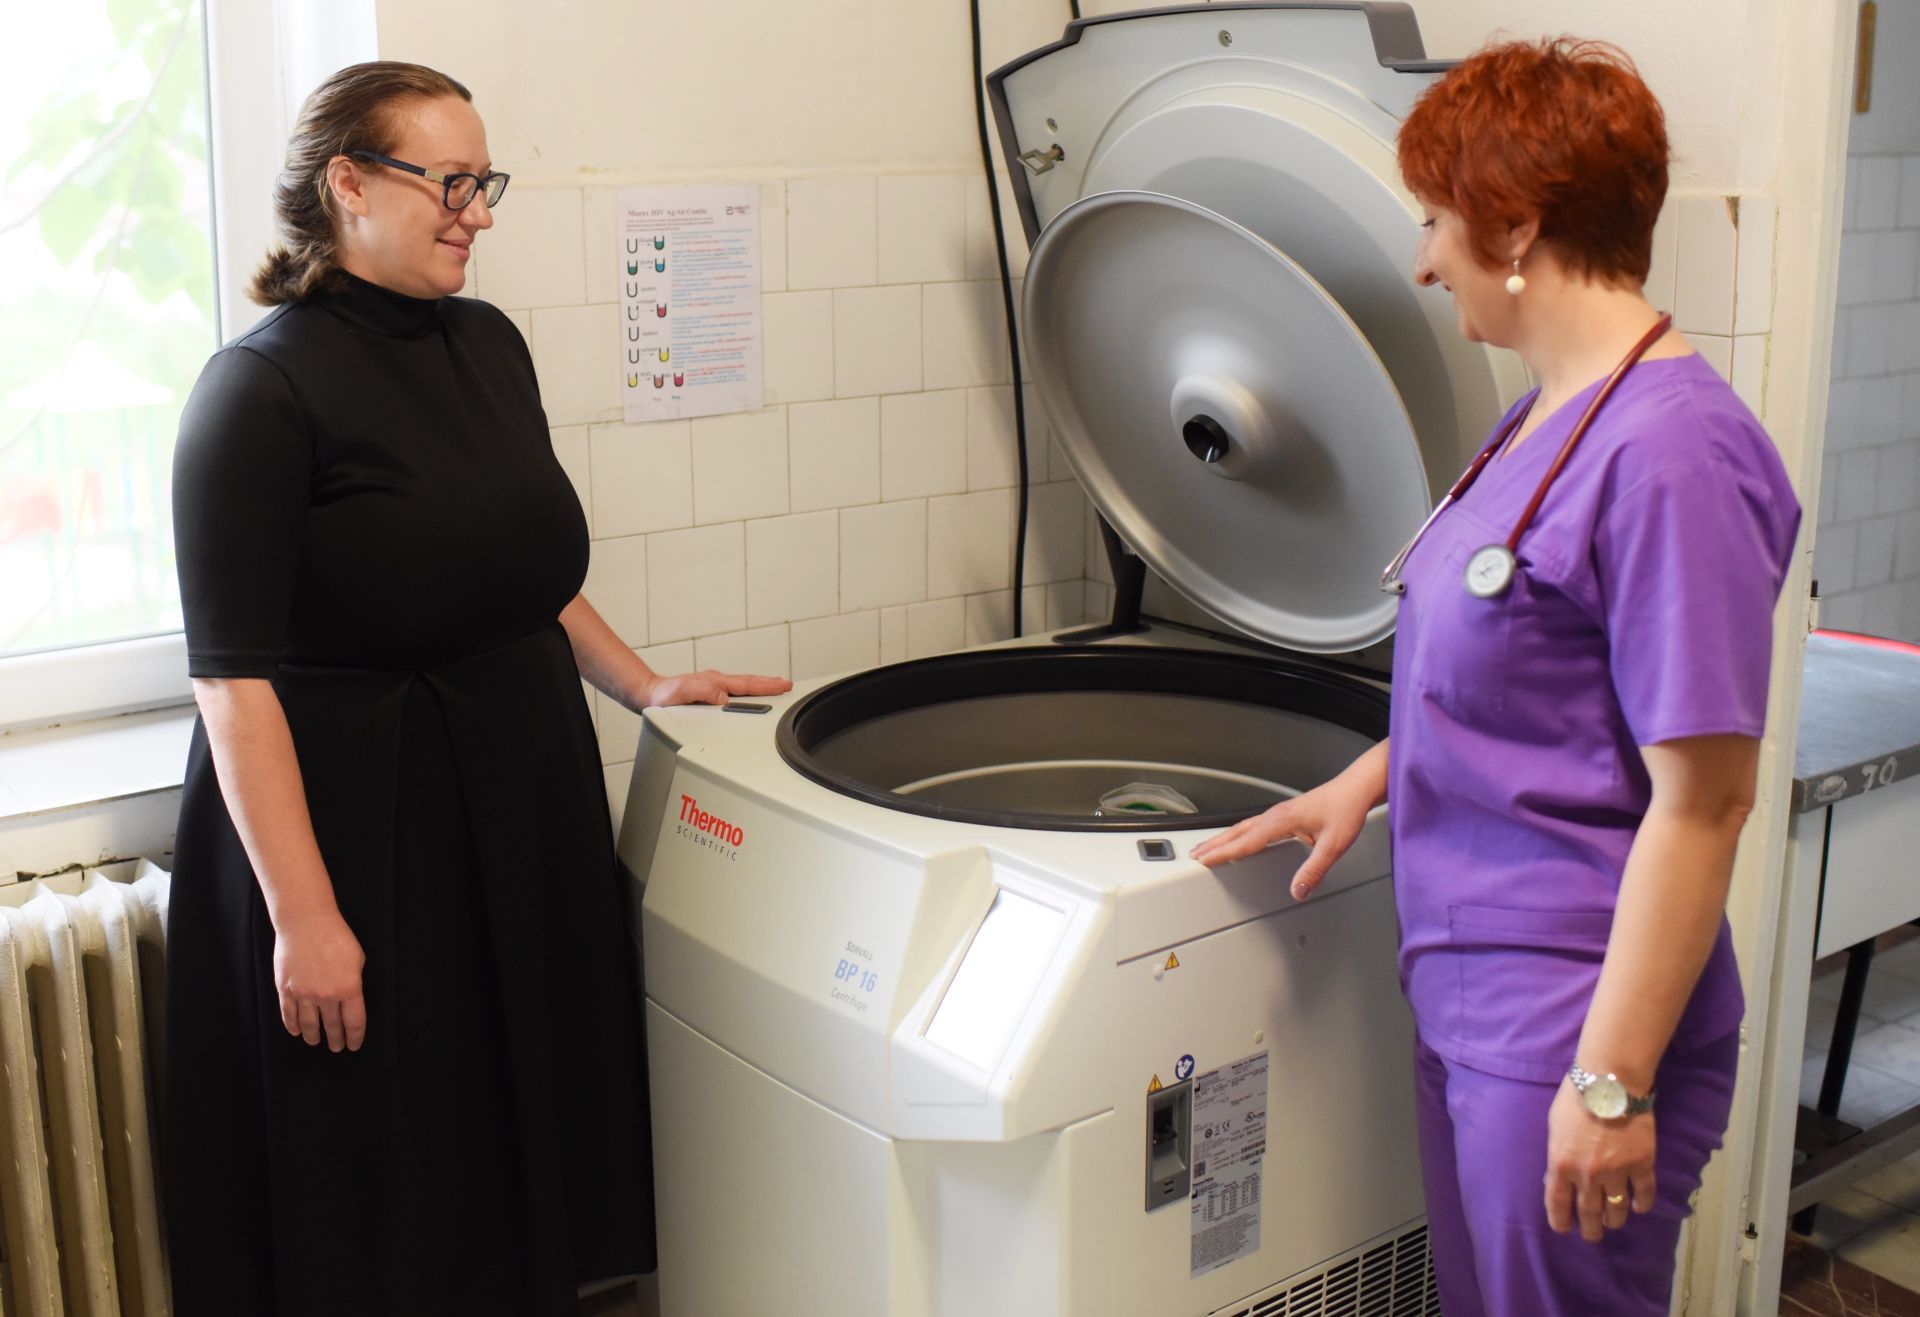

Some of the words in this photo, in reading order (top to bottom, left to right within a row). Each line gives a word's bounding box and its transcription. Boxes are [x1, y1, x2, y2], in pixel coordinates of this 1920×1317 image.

[650, 208, 663, 217] HIV
[686, 207, 707, 215] Combo
[680, 794, 743, 847] Thermo
[676, 825, 737, 862] SCIENTIFIC
[834, 959, 859, 982] BP
[860, 970, 878, 993] 16
[831, 986, 868, 1012] Centrifuge
